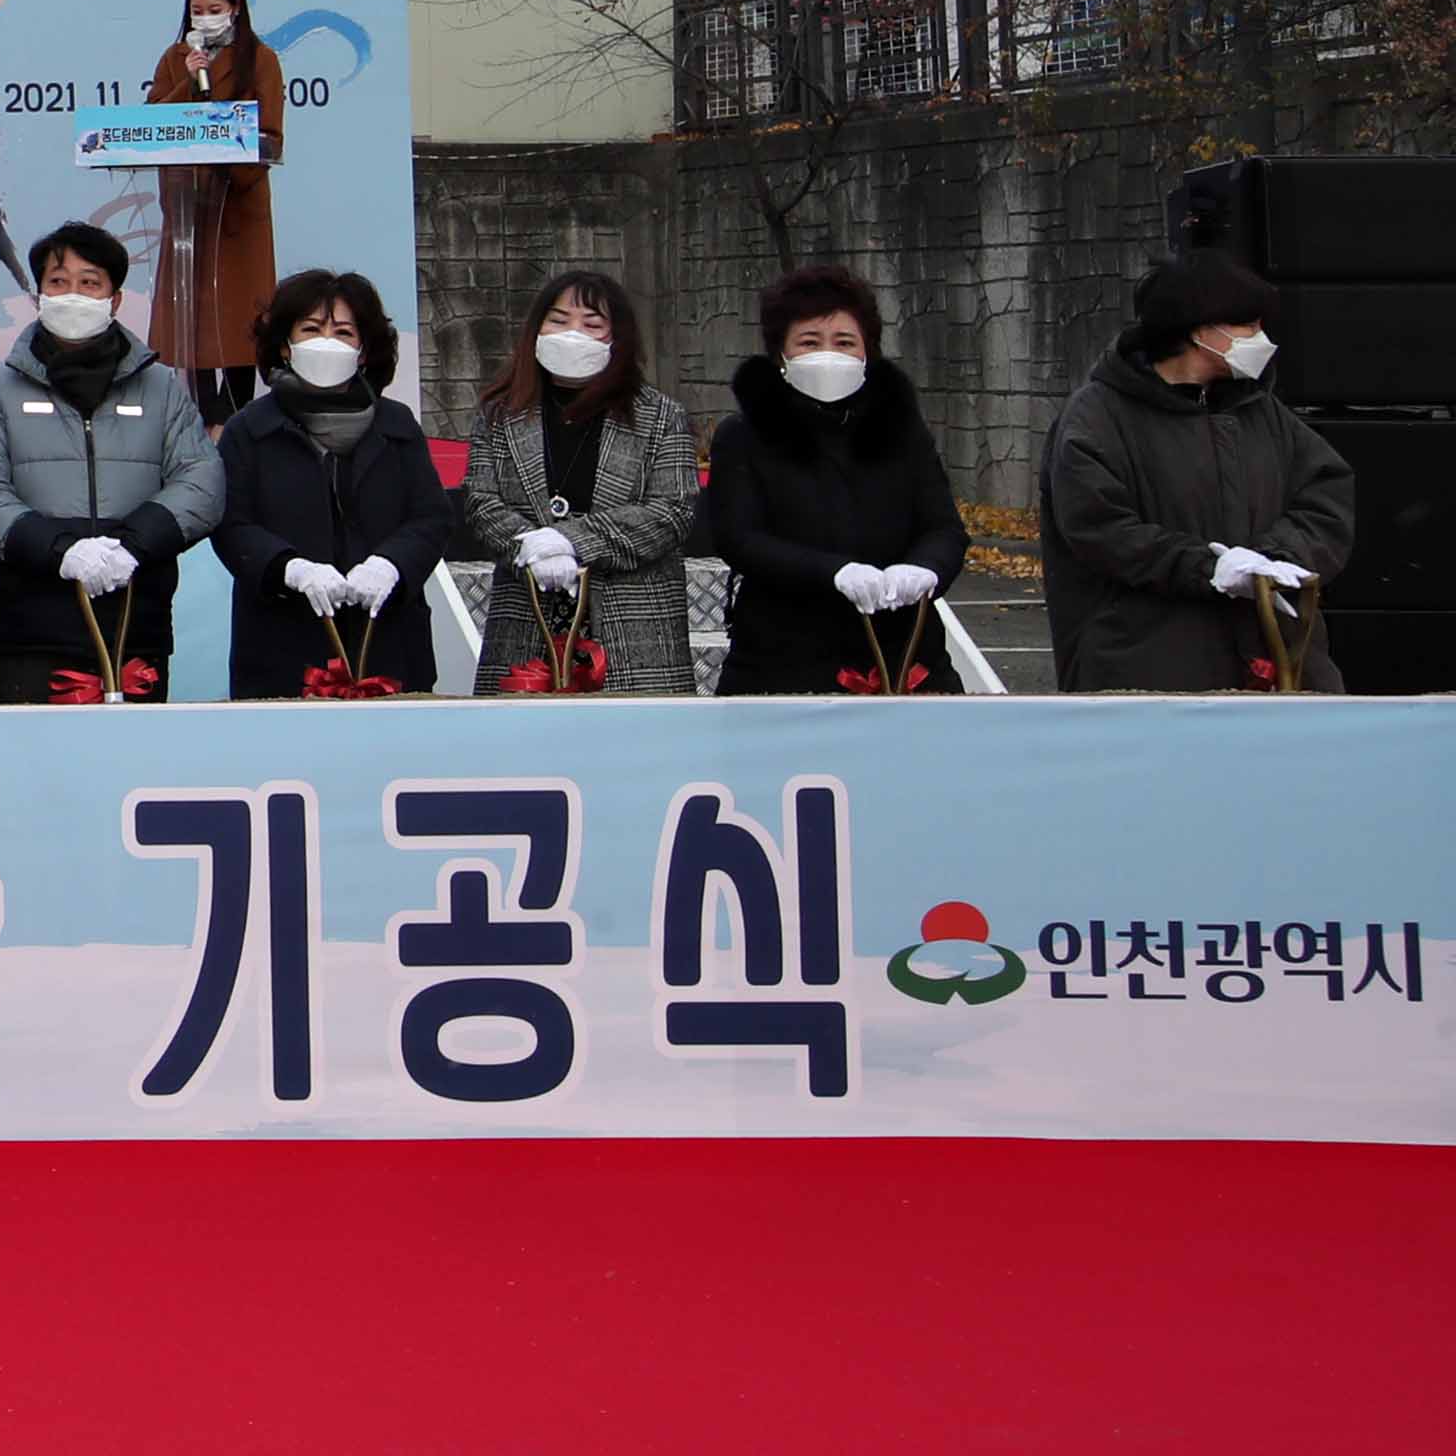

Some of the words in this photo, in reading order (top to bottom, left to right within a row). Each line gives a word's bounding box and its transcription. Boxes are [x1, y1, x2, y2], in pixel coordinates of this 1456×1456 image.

[101, 126, 153, 143] 꿈드림센터
[155, 125, 197, 142] 건립공사
[200, 124, 231, 140] 기공식
[134, 786, 849, 1103] 기공식
[1037, 919, 1424, 1004] 인천광역시
